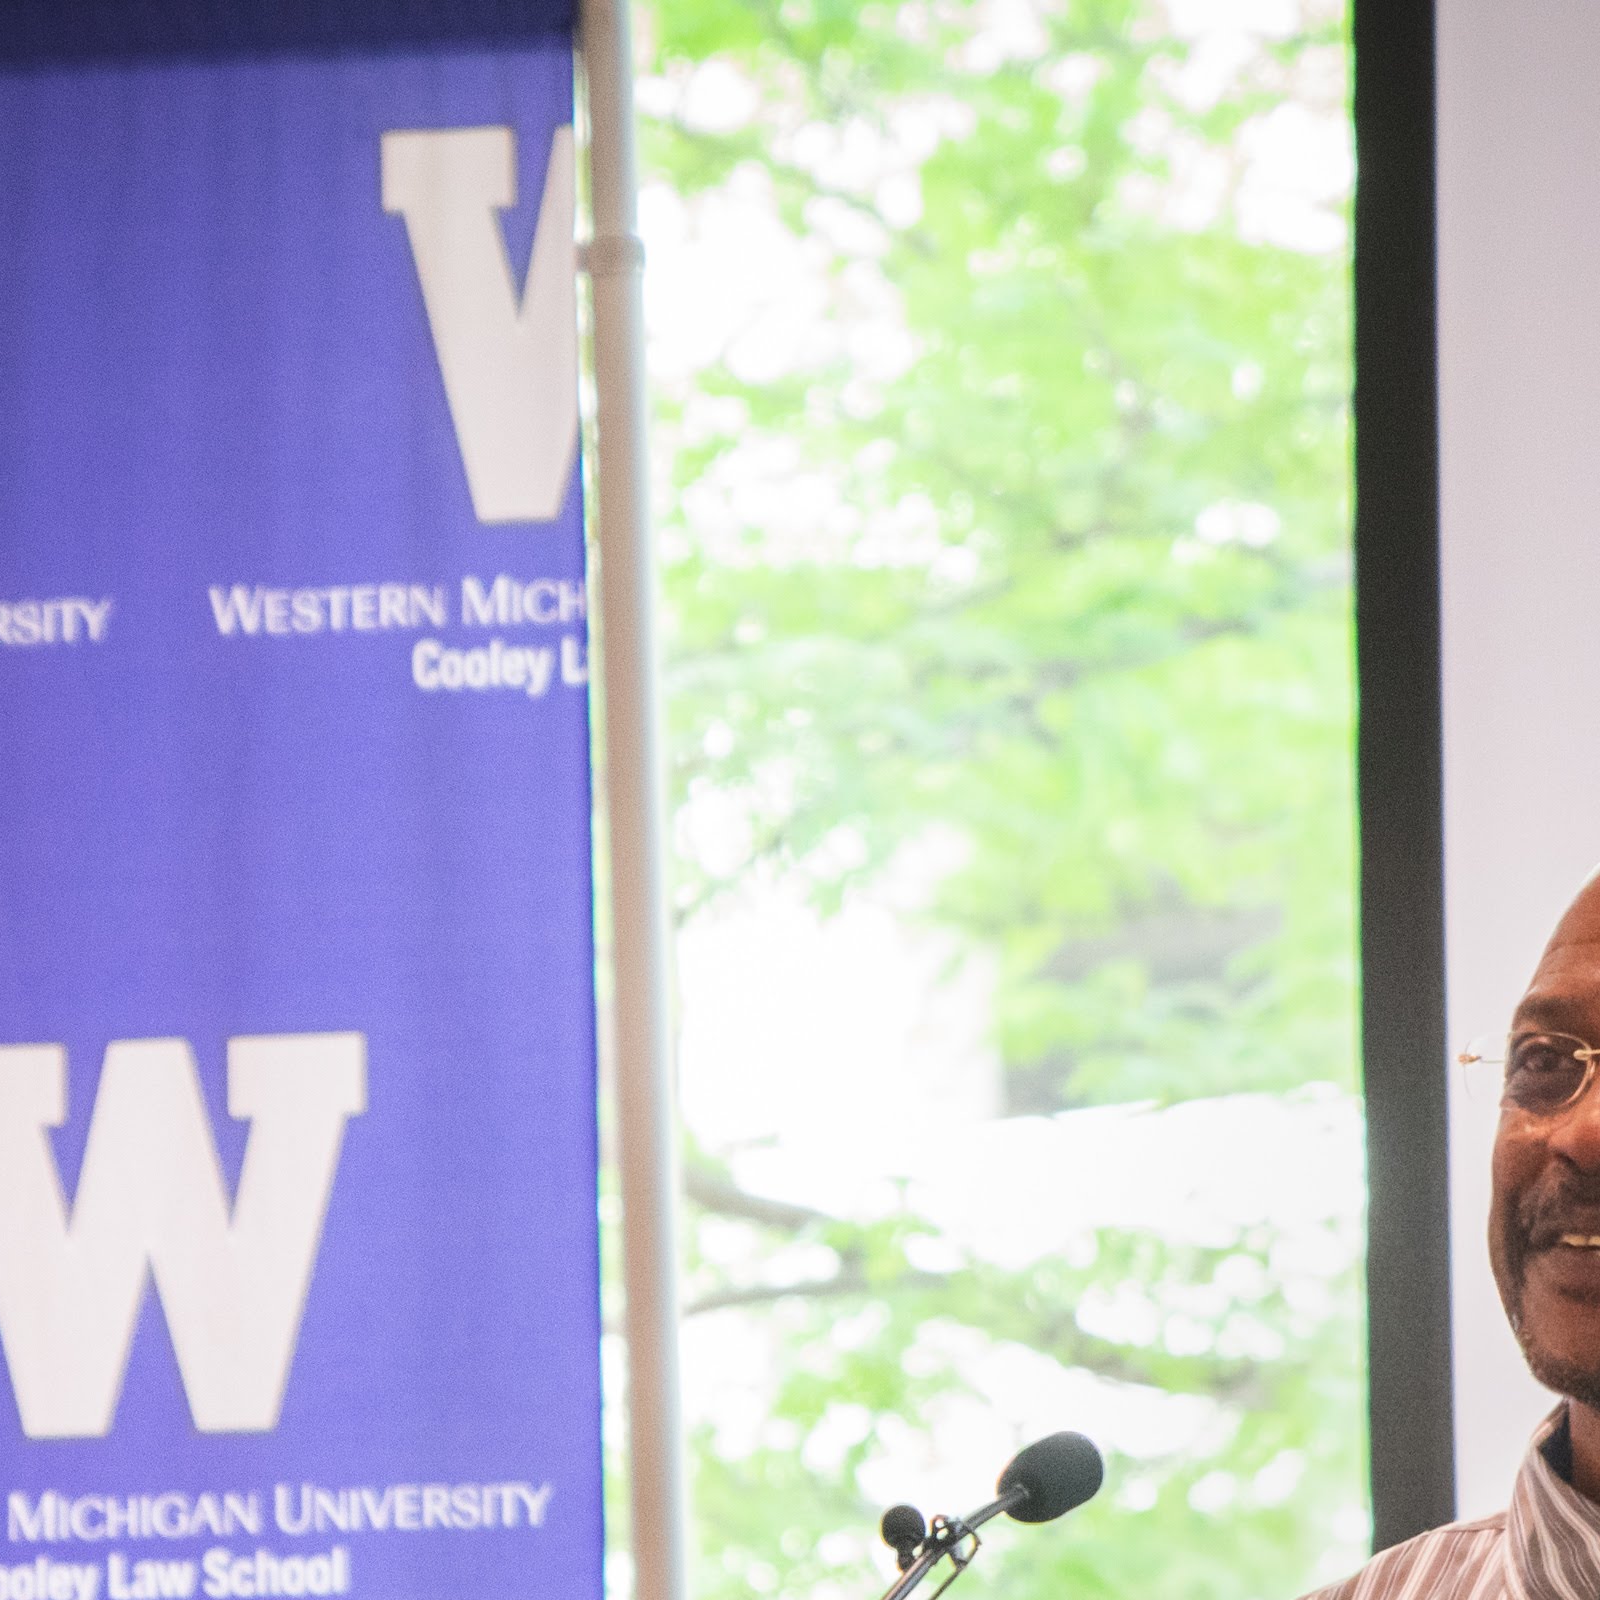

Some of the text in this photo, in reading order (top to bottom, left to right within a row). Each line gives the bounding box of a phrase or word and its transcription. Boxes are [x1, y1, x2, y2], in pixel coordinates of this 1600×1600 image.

[209, 582, 445, 635] WESTERN
[412, 638, 553, 699] Cooley
[8, 1490, 260, 1544] MICHIGAN
[274, 1482, 552, 1536] UNIVERSITY
[203, 1546, 349, 1597] School
